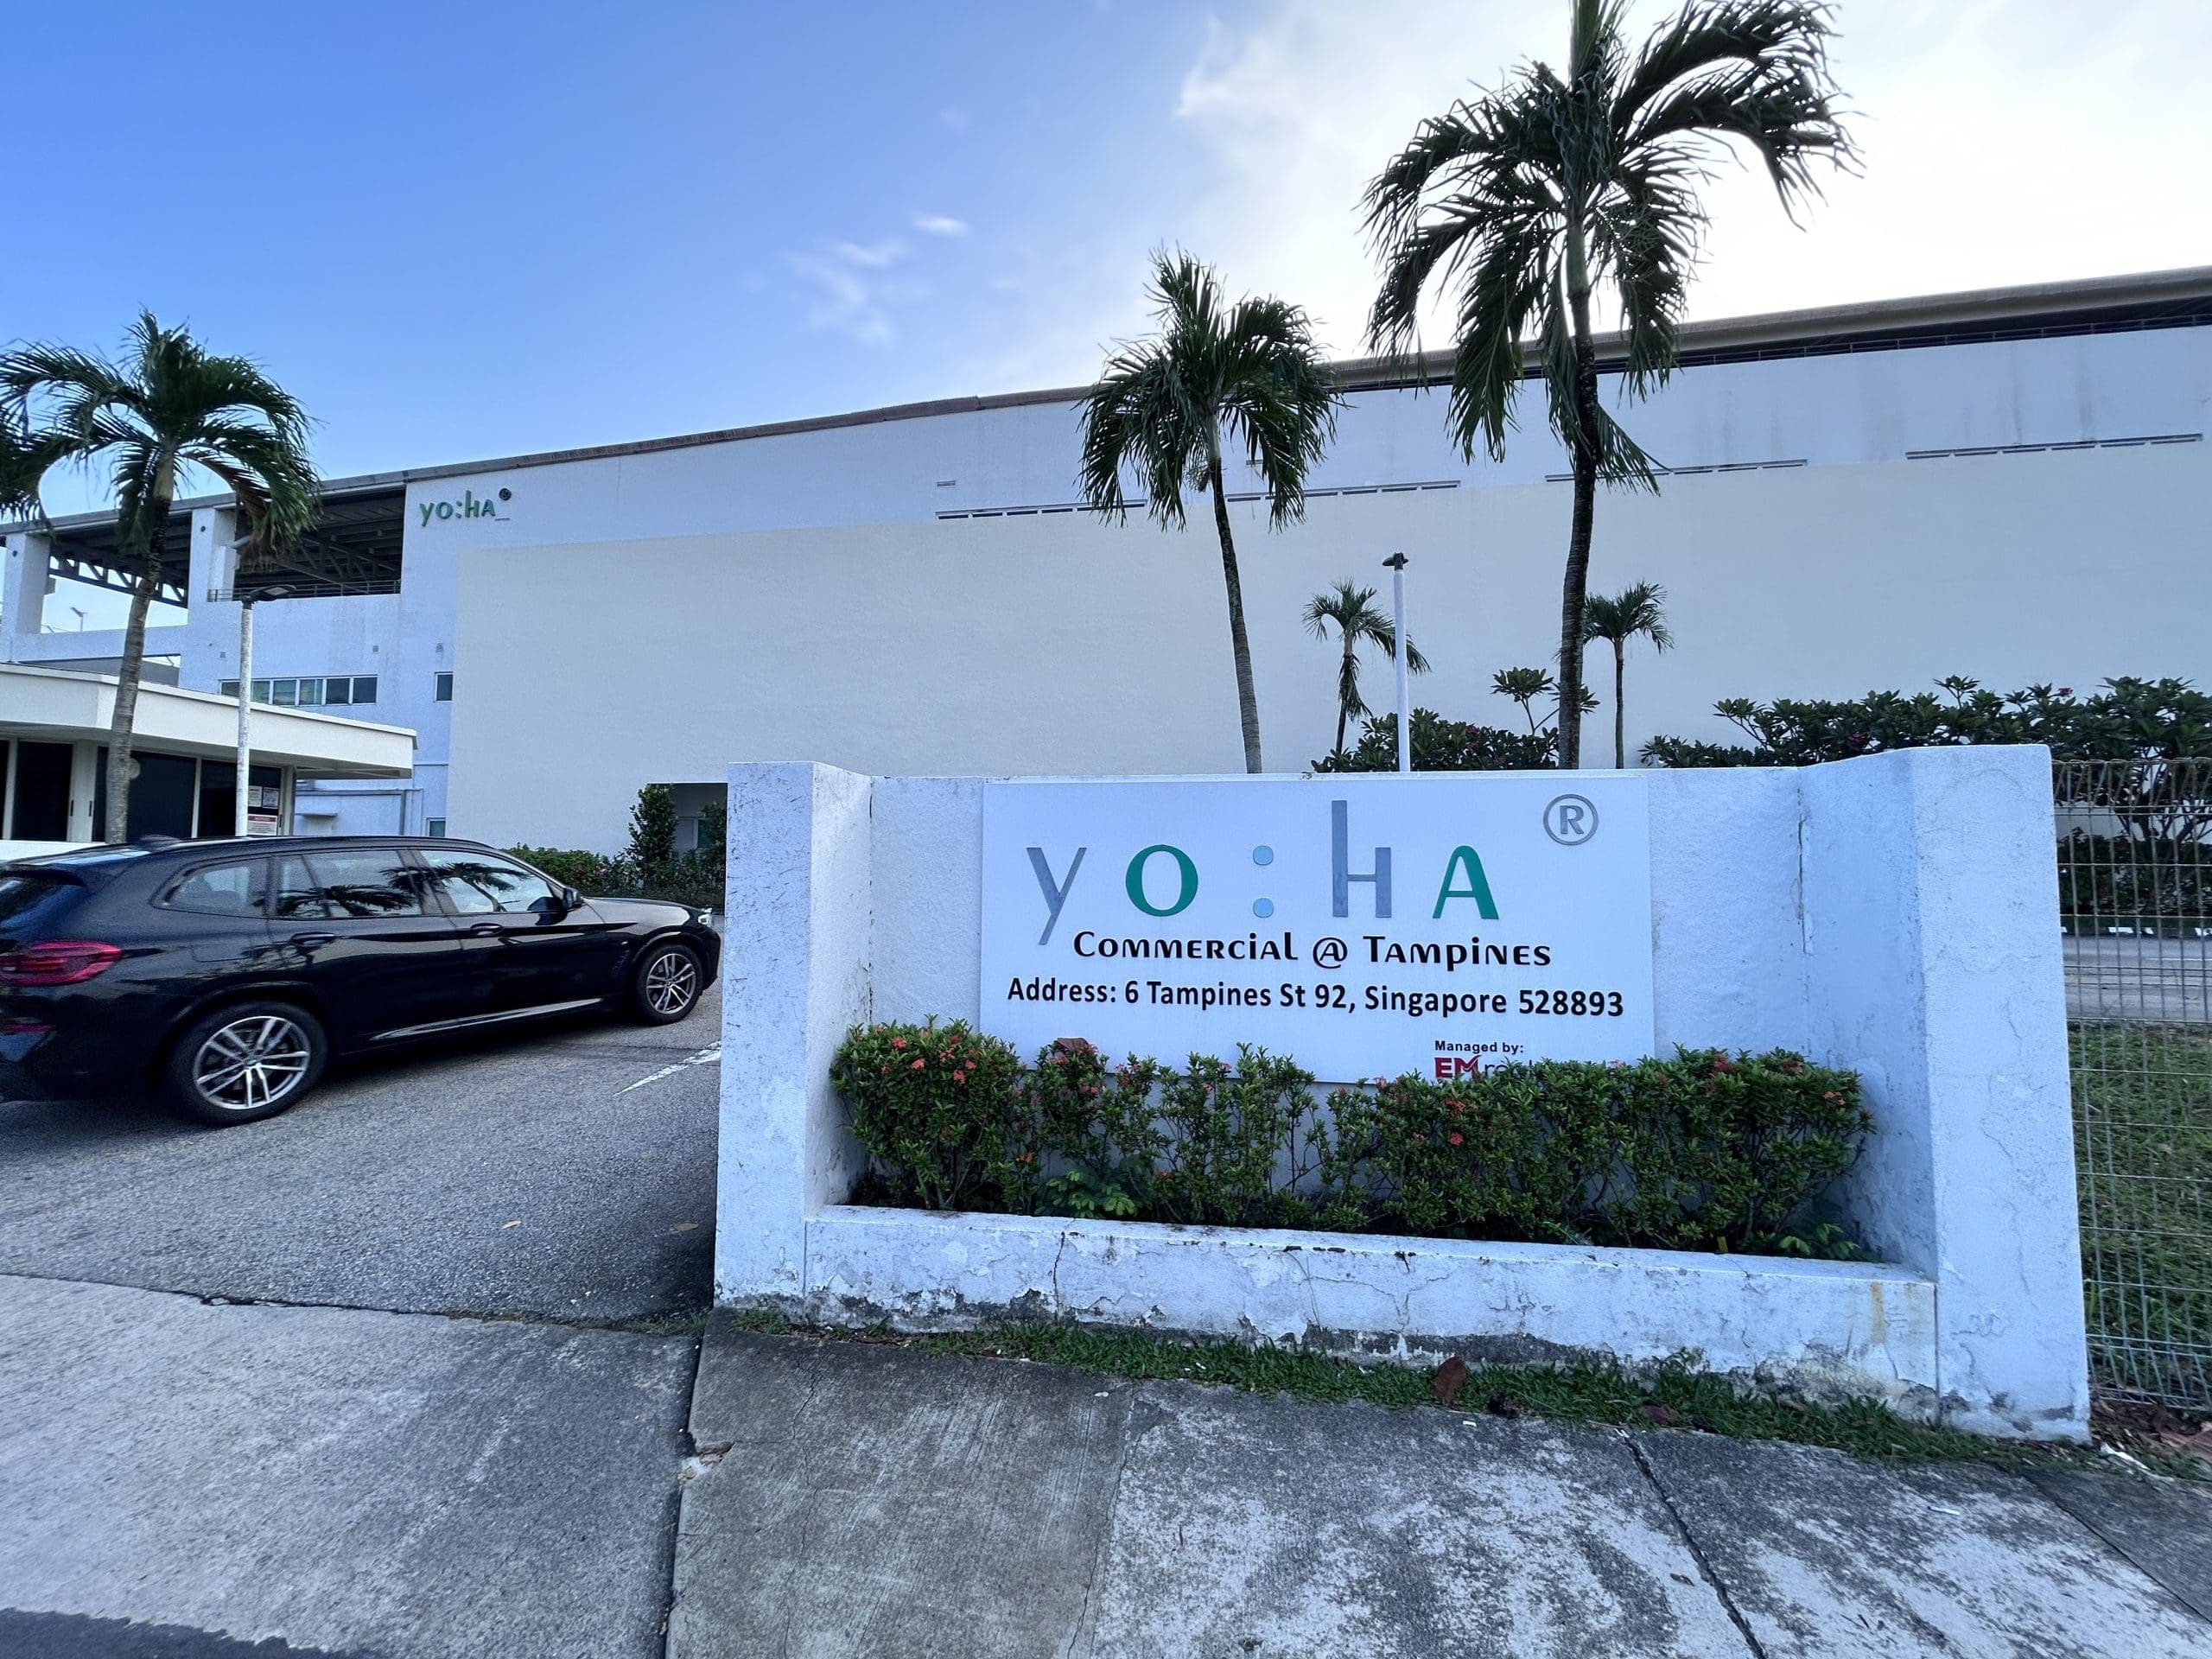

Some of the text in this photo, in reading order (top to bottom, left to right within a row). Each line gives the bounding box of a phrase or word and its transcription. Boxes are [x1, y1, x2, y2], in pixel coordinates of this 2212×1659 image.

[1312, 937, 1349, 969] @
[1007, 976, 1624, 1019] Address: 6 Tampines St 92, Singapore 528893
[1434, 1039, 1524, 1055] Managed by:
